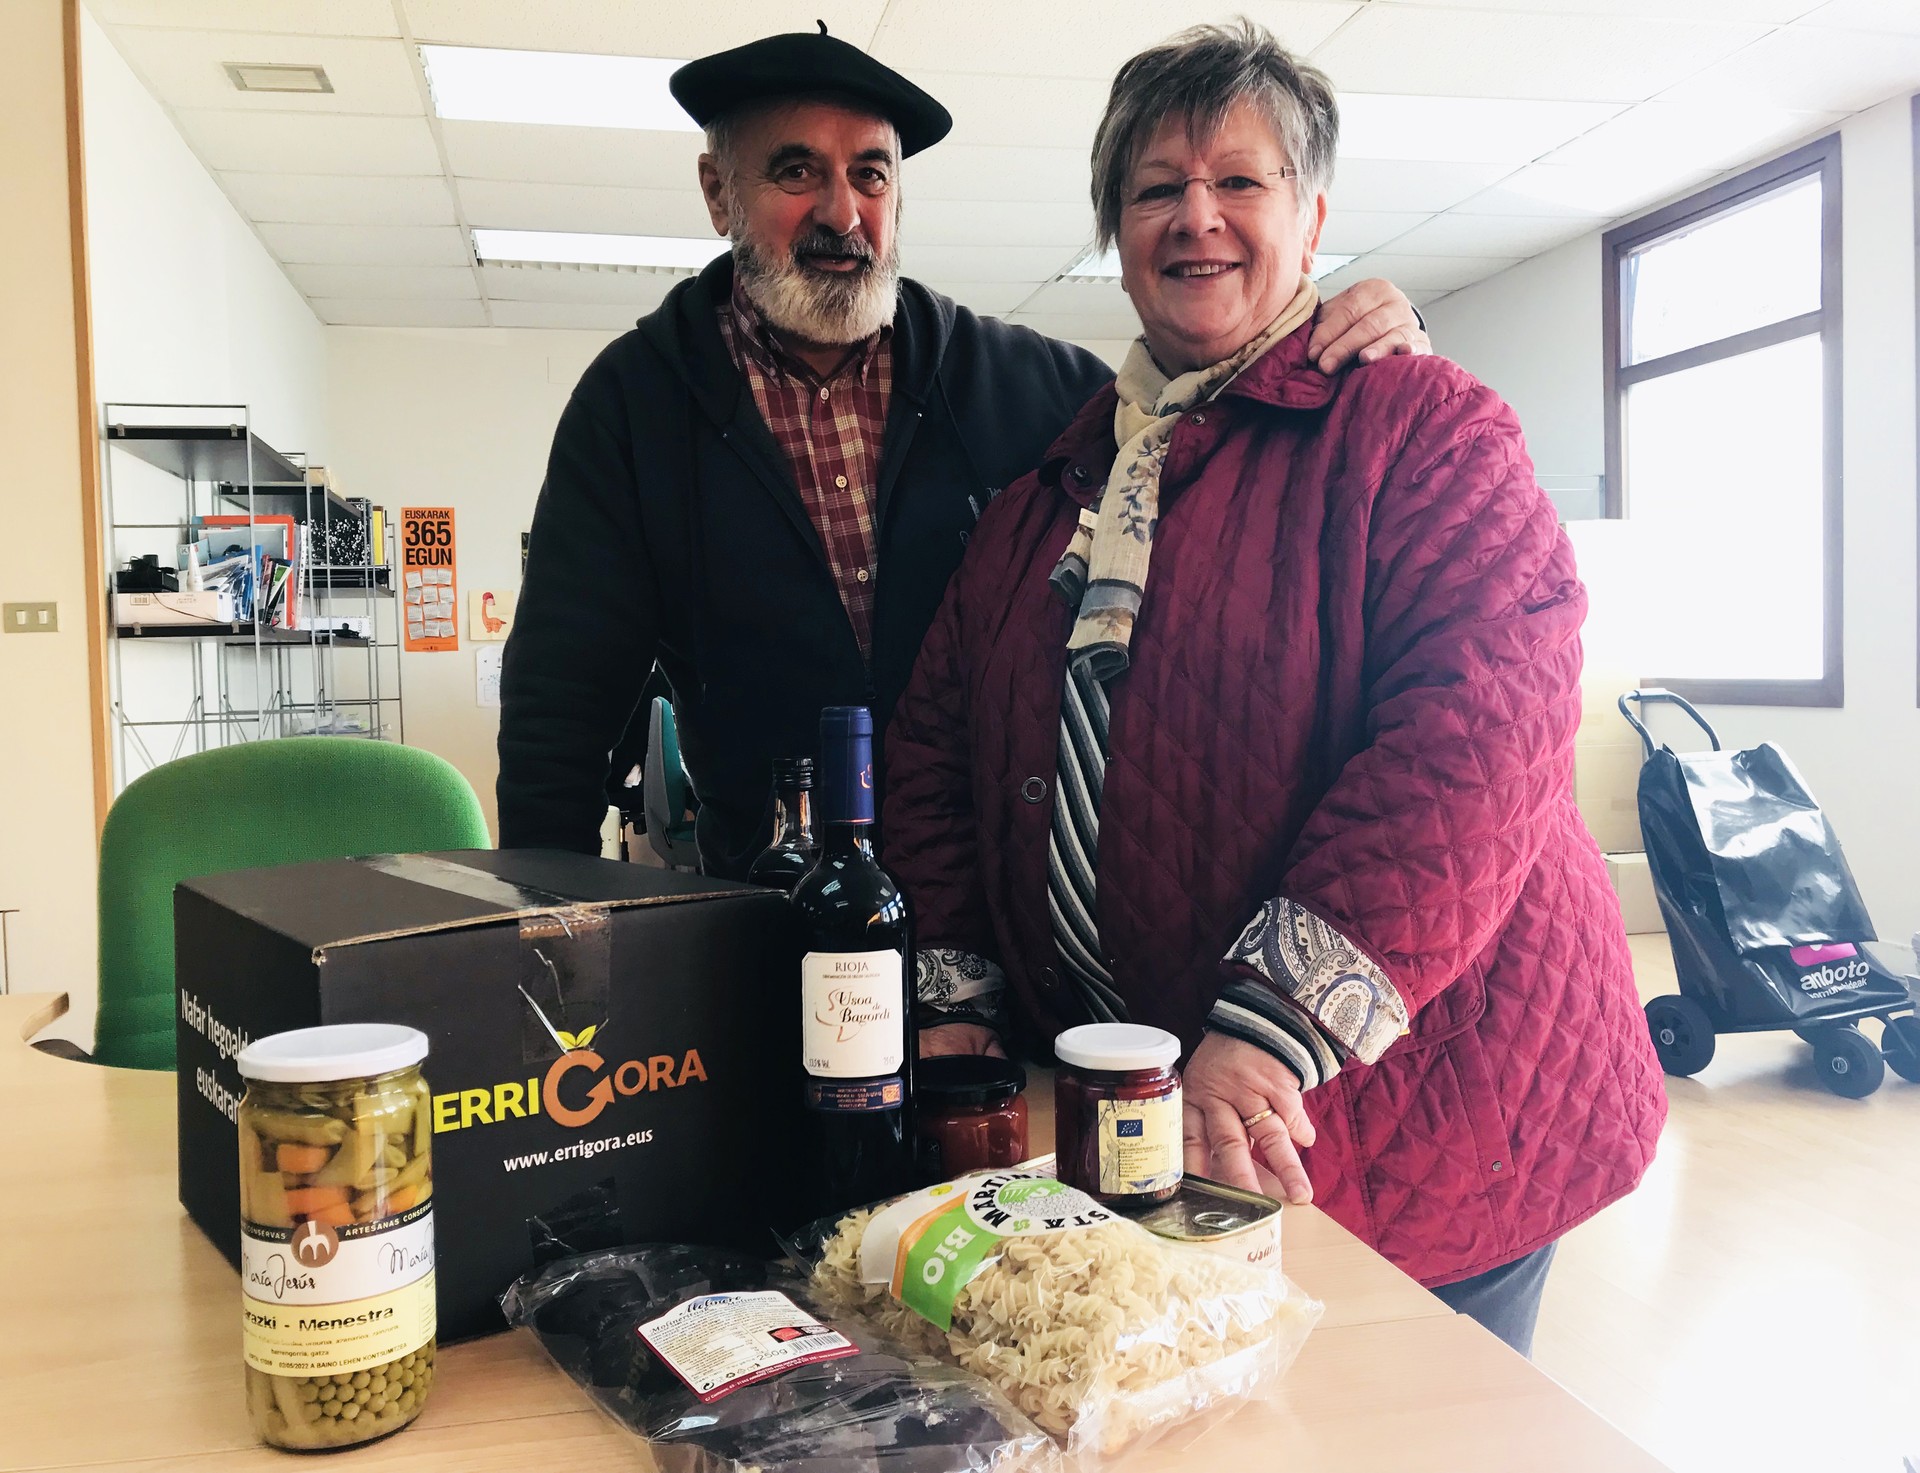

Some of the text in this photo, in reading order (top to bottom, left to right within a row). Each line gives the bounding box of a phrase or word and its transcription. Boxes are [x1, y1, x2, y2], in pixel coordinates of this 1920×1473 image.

[405, 510, 450, 519] EUSKARAK
[405, 520, 451, 546] 365
[405, 547, 452, 566] EGUN
[835, 961, 869, 973] RIOJA
[1800, 961, 1870, 991] anboto
[835, 991, 872, 1006] Usoa
[181, 988, 206, 1035] Nafar
[839, 1006, 890, 1027] Bagordi
[503, 1128, 653, 1172] www.errigora.eus
[345, 1218, 400, 1237] ARTESANAS
[266, 1253, 316, 1299] Jesús
[299, 1307, 394, 1332] Menestra
[339, 1357, 361, 1367] LEHEN
[757, 1348, 788, 1360] 250g
